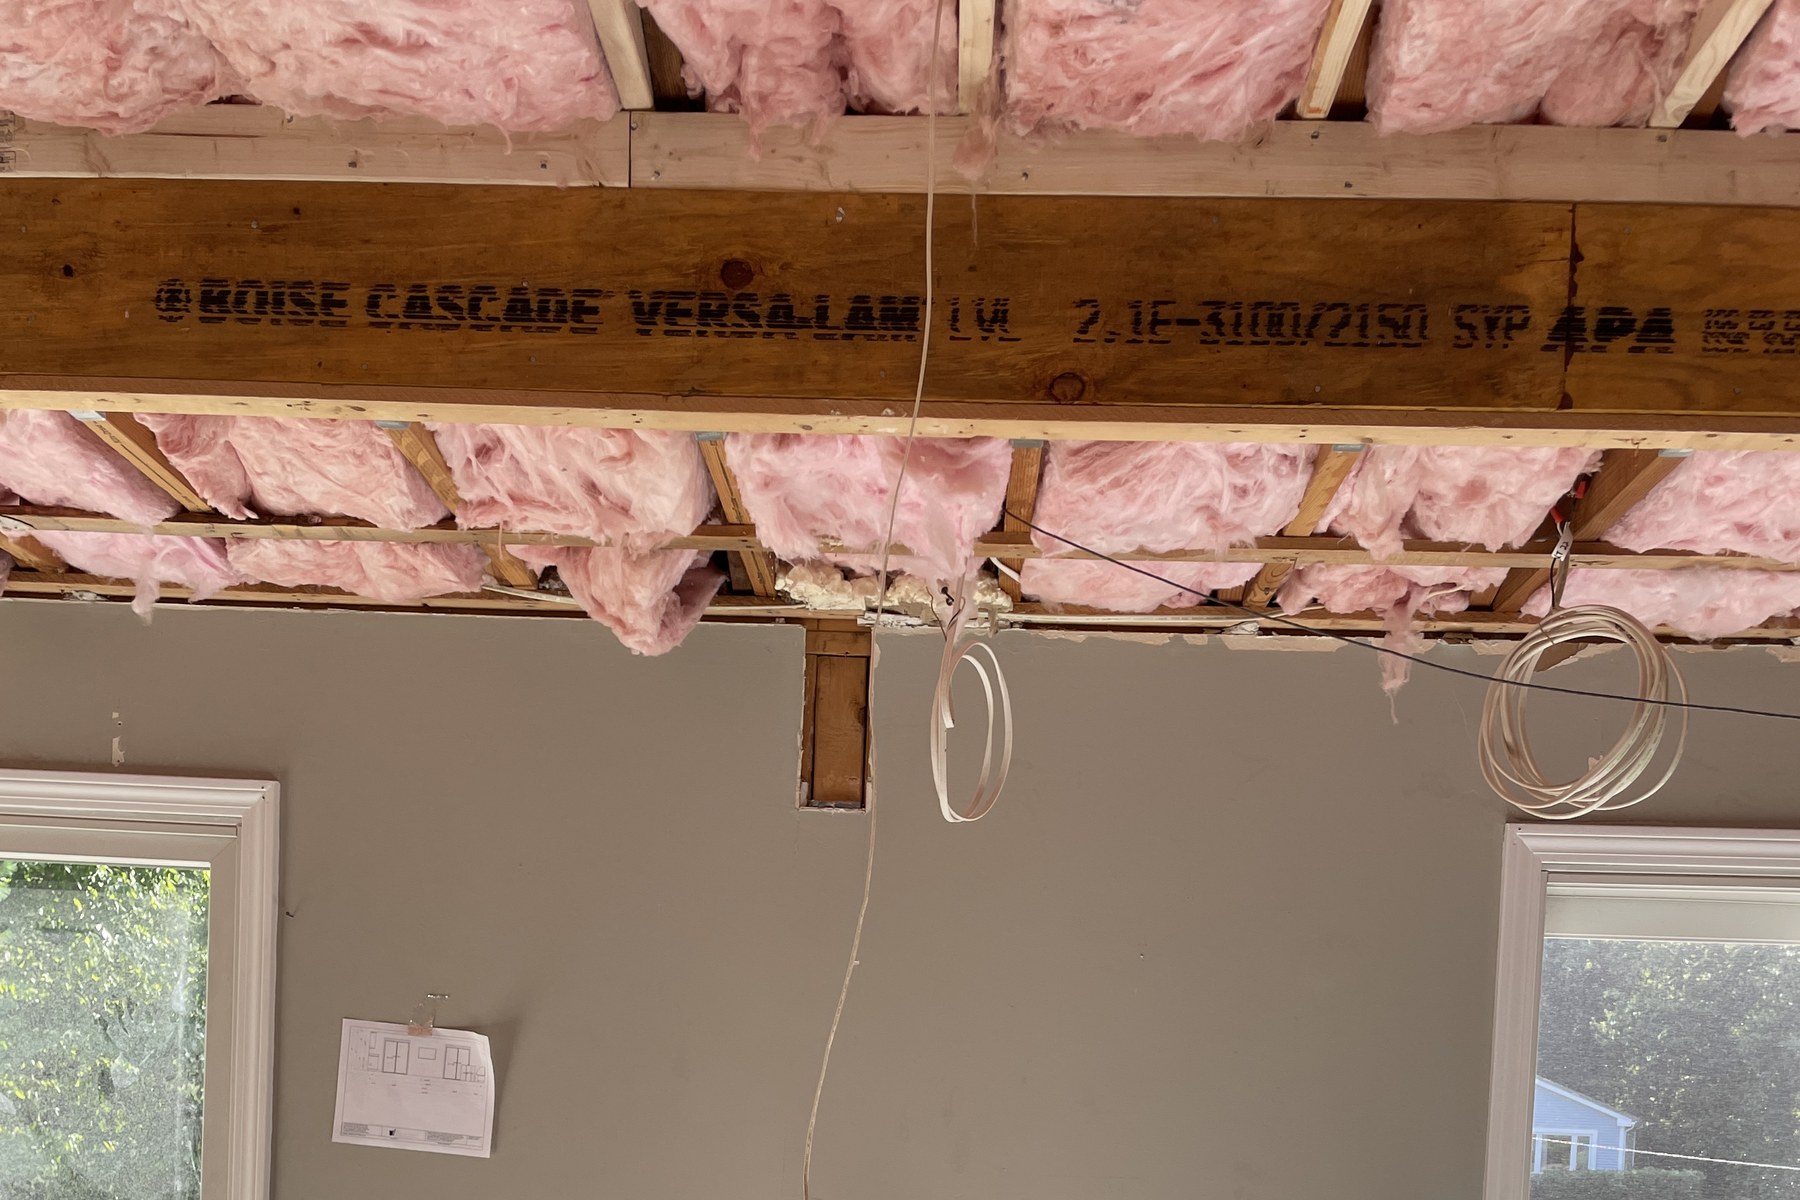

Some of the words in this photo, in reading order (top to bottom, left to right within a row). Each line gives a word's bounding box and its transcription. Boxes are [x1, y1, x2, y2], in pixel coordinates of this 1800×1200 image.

[199, 278, 352, 327] BOISE
[365, 283, 604, 334] CASCADE
[1540, 306, 1677, 355] APA
